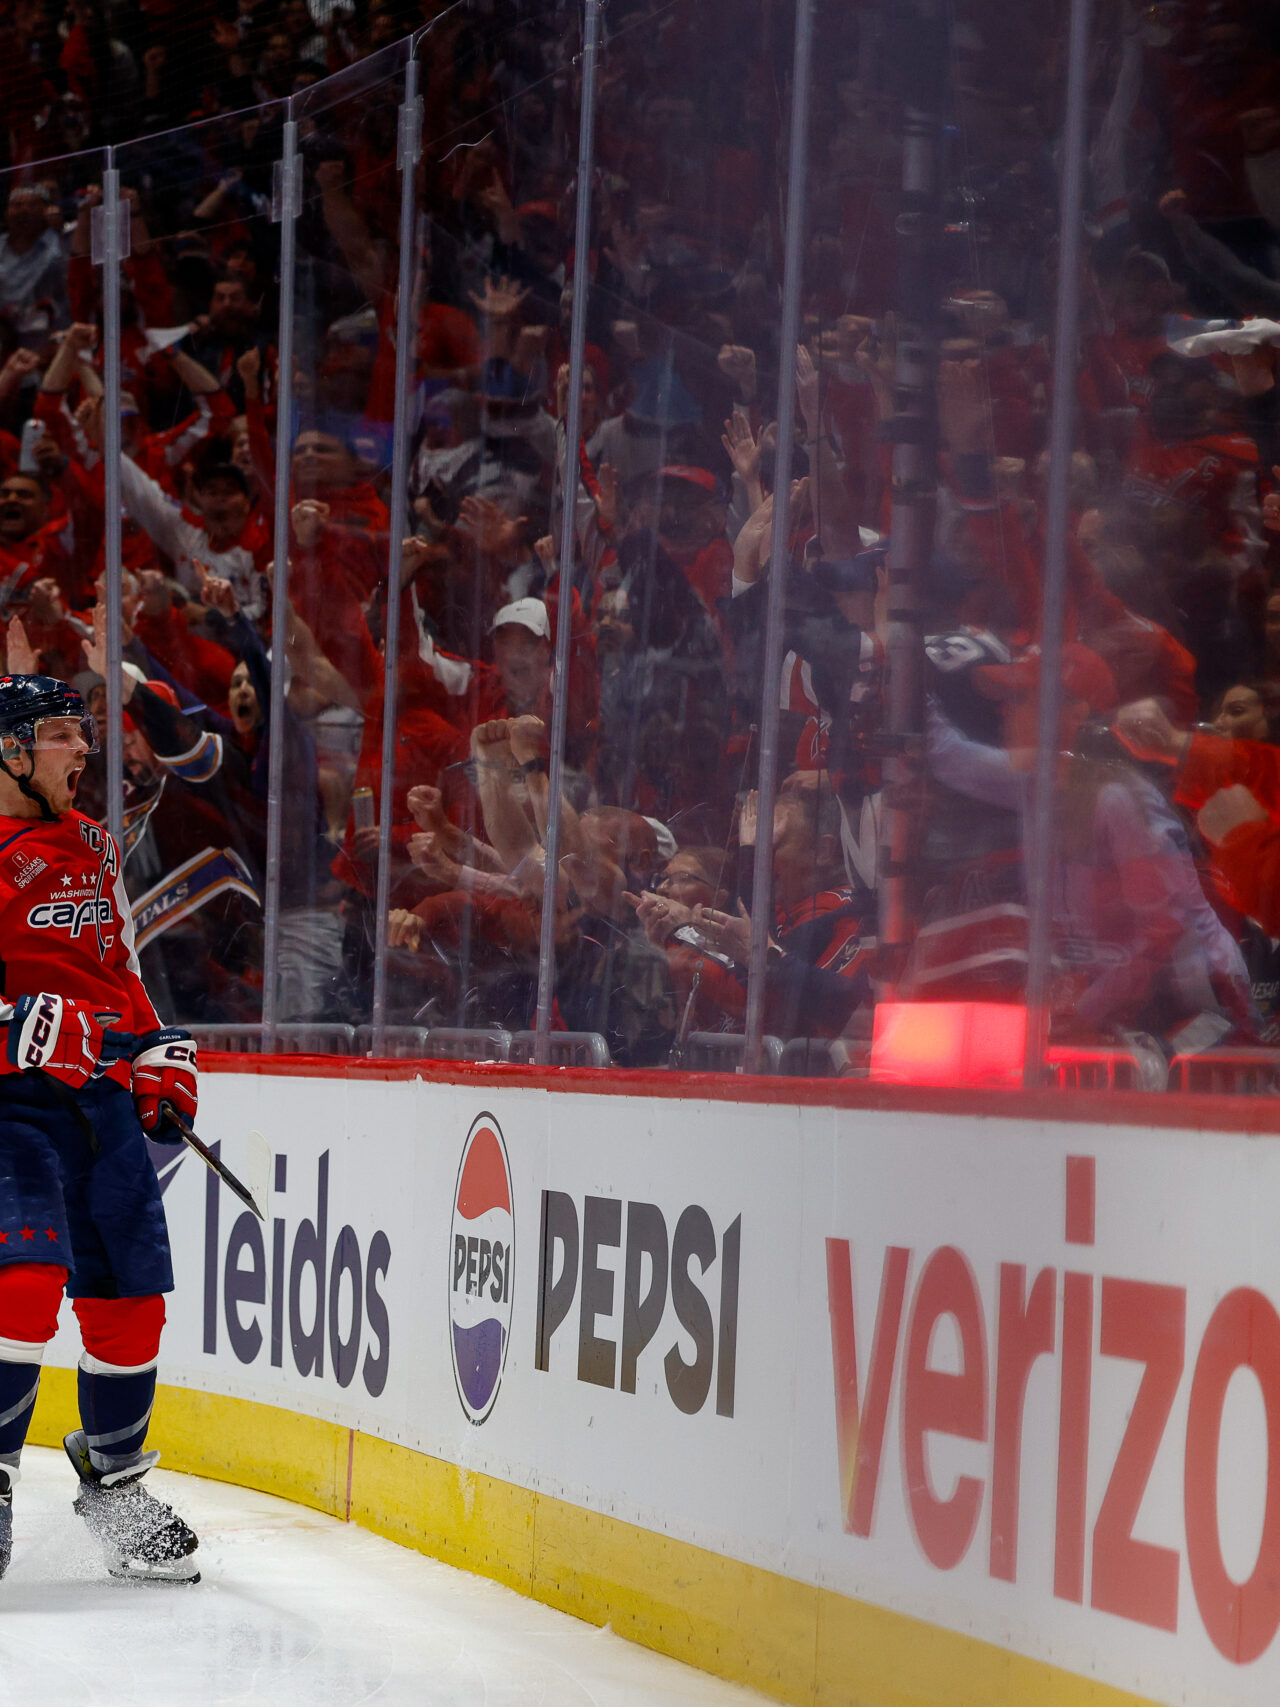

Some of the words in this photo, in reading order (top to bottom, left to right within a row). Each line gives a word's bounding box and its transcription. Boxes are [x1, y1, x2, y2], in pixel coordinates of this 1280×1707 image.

[13, 856, 44, 883] CAESARS
[17, 862, 48, 889] SPORTSBOOK
[103, 832, 117, 877] A
[133, 882, 190, 933] ITALS
[24, 993, 58, 1066] CCM
[202, 1139, 392, 1398] leidos
[452, 1233, 511, 1304] PEPSI
[534, 1189, 742, 1419] PEPSI
[824, 1154, 1280, 1667] verizo
